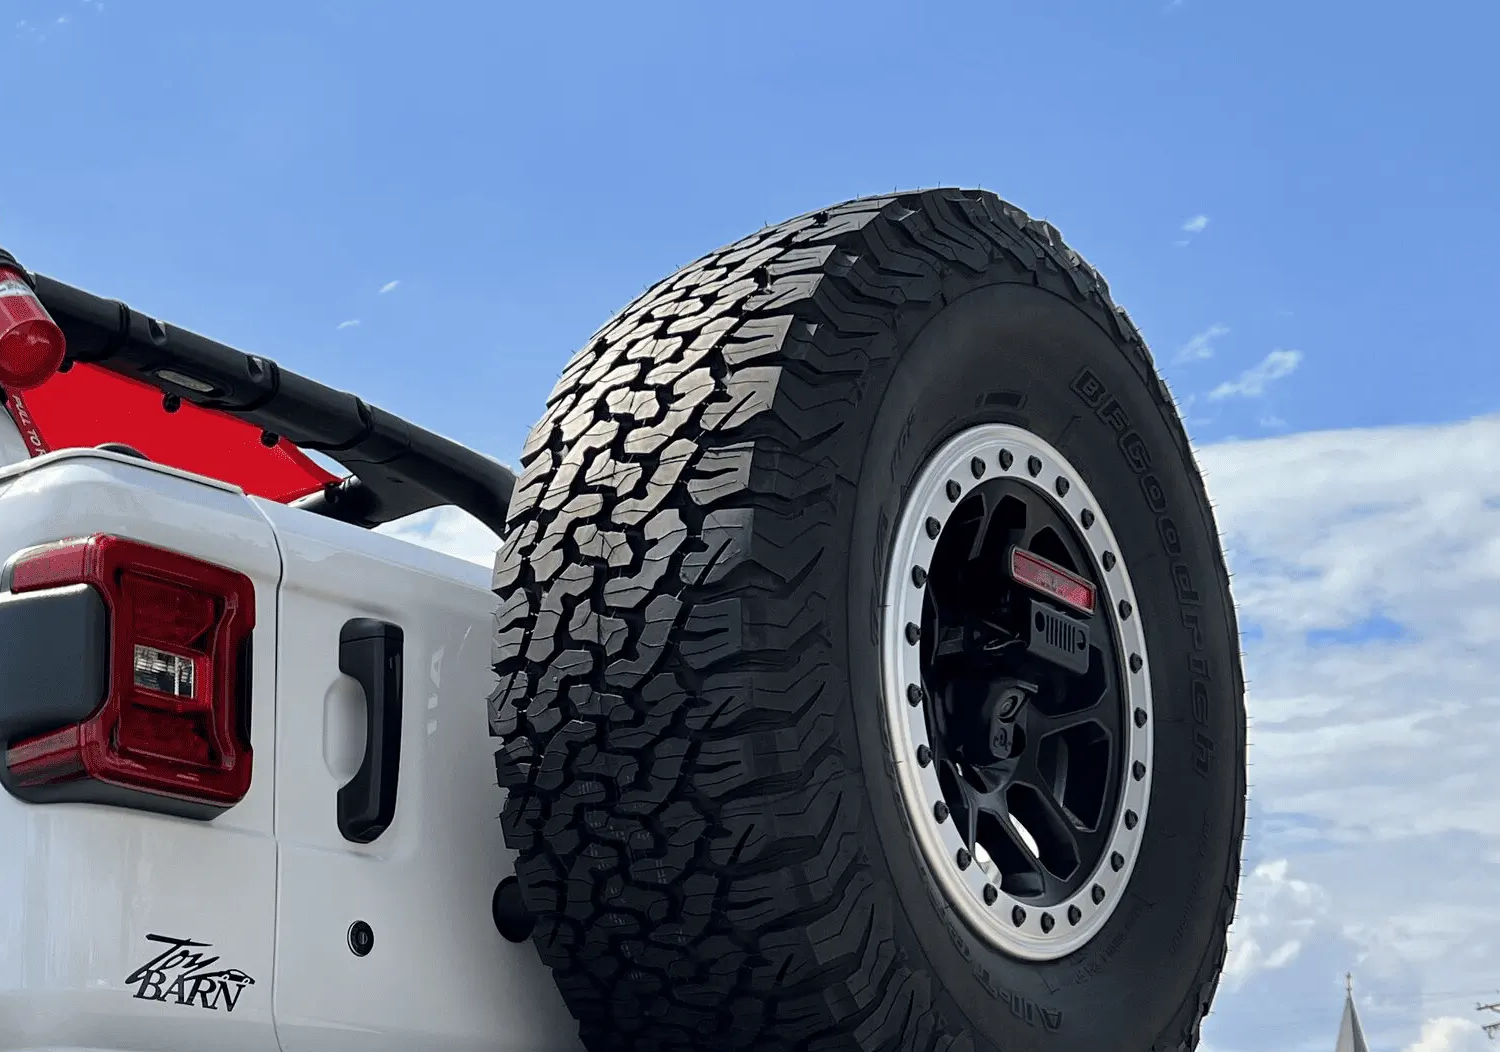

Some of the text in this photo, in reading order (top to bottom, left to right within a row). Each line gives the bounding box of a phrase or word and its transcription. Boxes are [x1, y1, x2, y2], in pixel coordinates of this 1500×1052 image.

[28, 429, 41, 446] TO
[1069, 366, 1219, 780] BFGoodrich
[125, 933, 220, 985] Toy
[133, 969, 246, 1013] BARN
